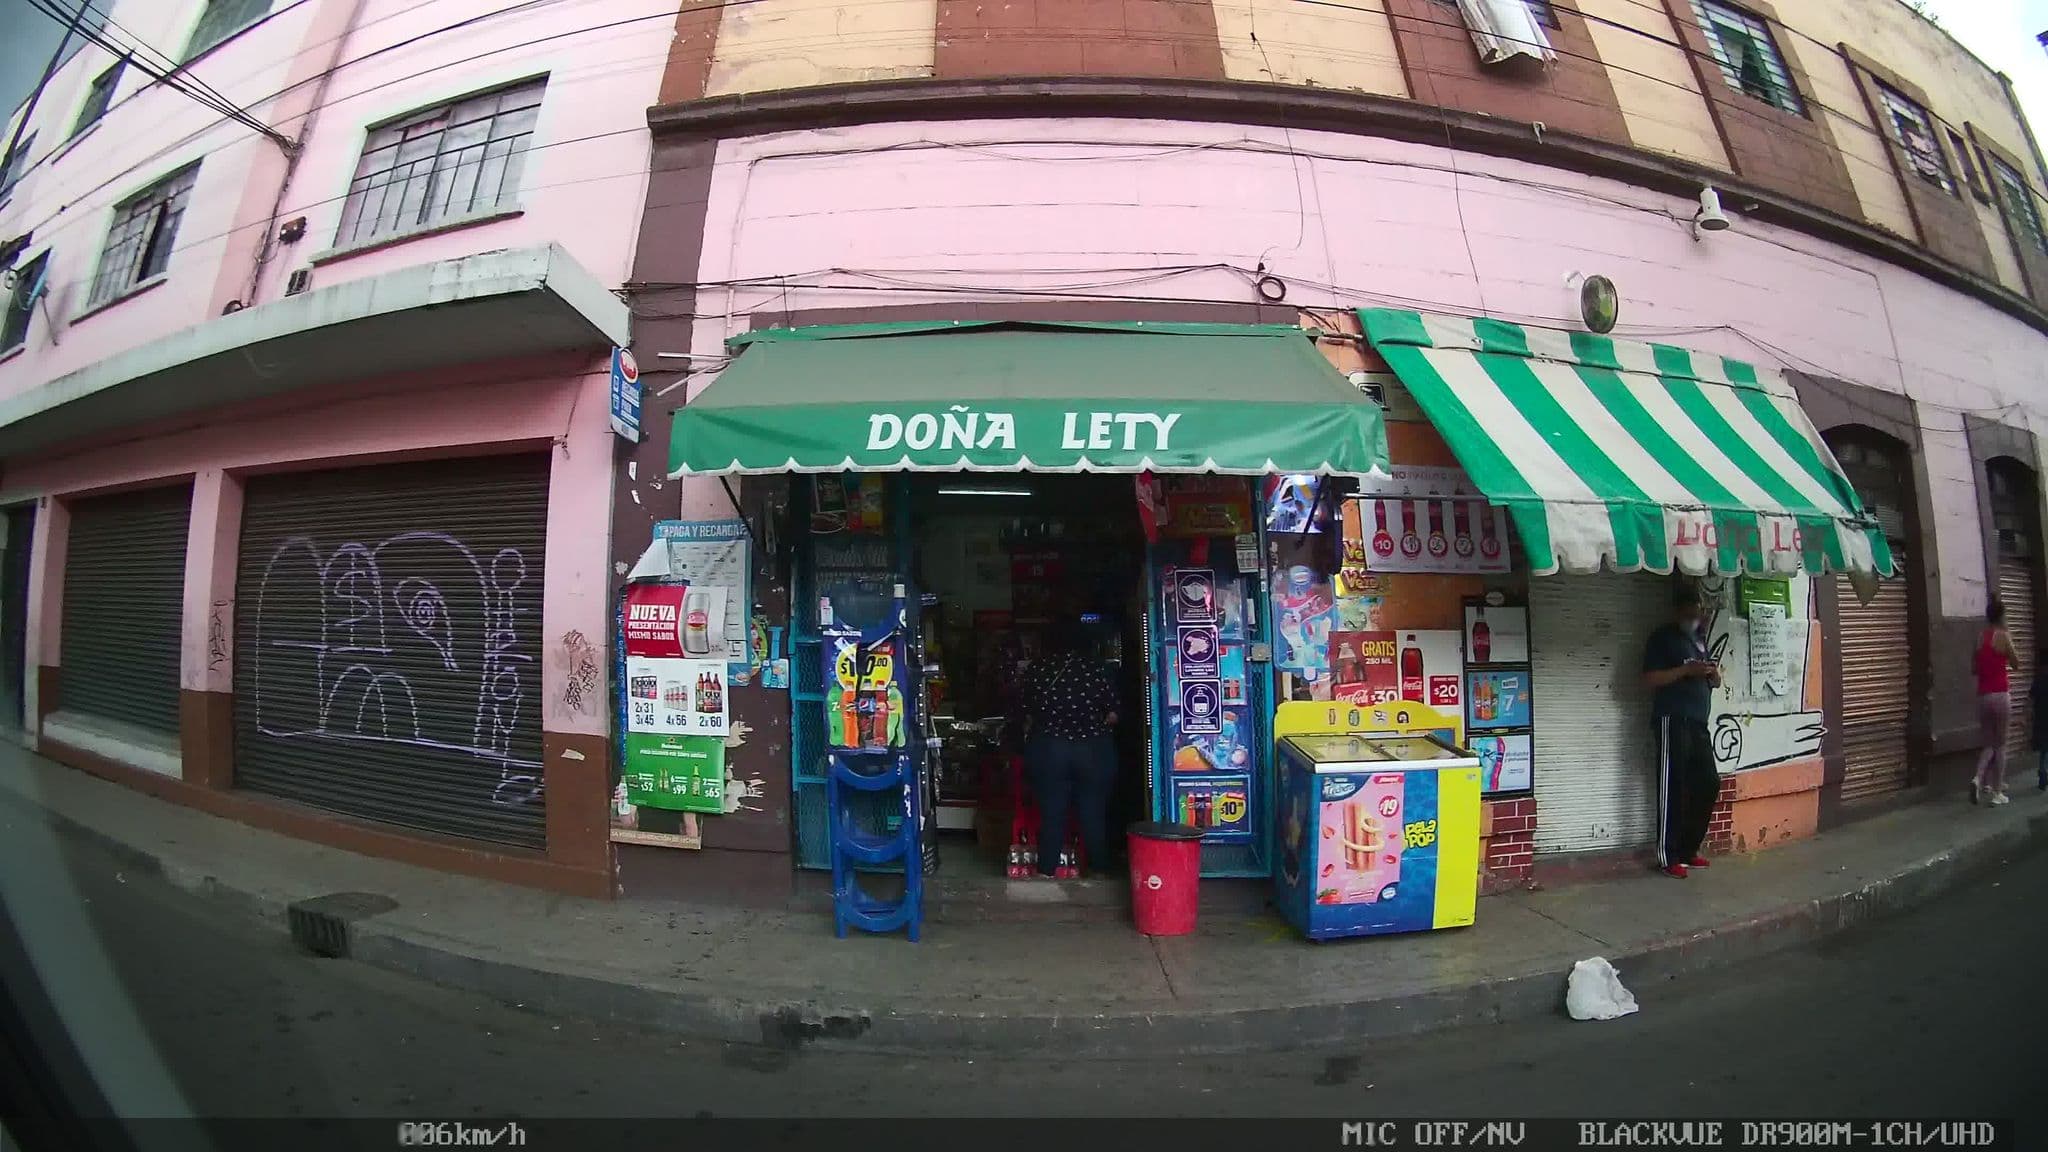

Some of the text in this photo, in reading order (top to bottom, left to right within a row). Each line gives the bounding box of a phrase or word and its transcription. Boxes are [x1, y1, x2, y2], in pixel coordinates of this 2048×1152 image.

[866, 405, 1182, 452] DOÑA LETY
[691, 524, 701, 537] Y
[629, 604, 676, 621] NUEVA
[652, 631, 675, 641] SABOR
[1361, 640, 1396, 657] GRATIS
[1370, 690, 1398, 704] $30
[1433, 684, 1458, 697] $20
[673, 785, 687, 795] $99
[705, 787, 720, 798] $65
[1408, 833, 1435, 849] POP
